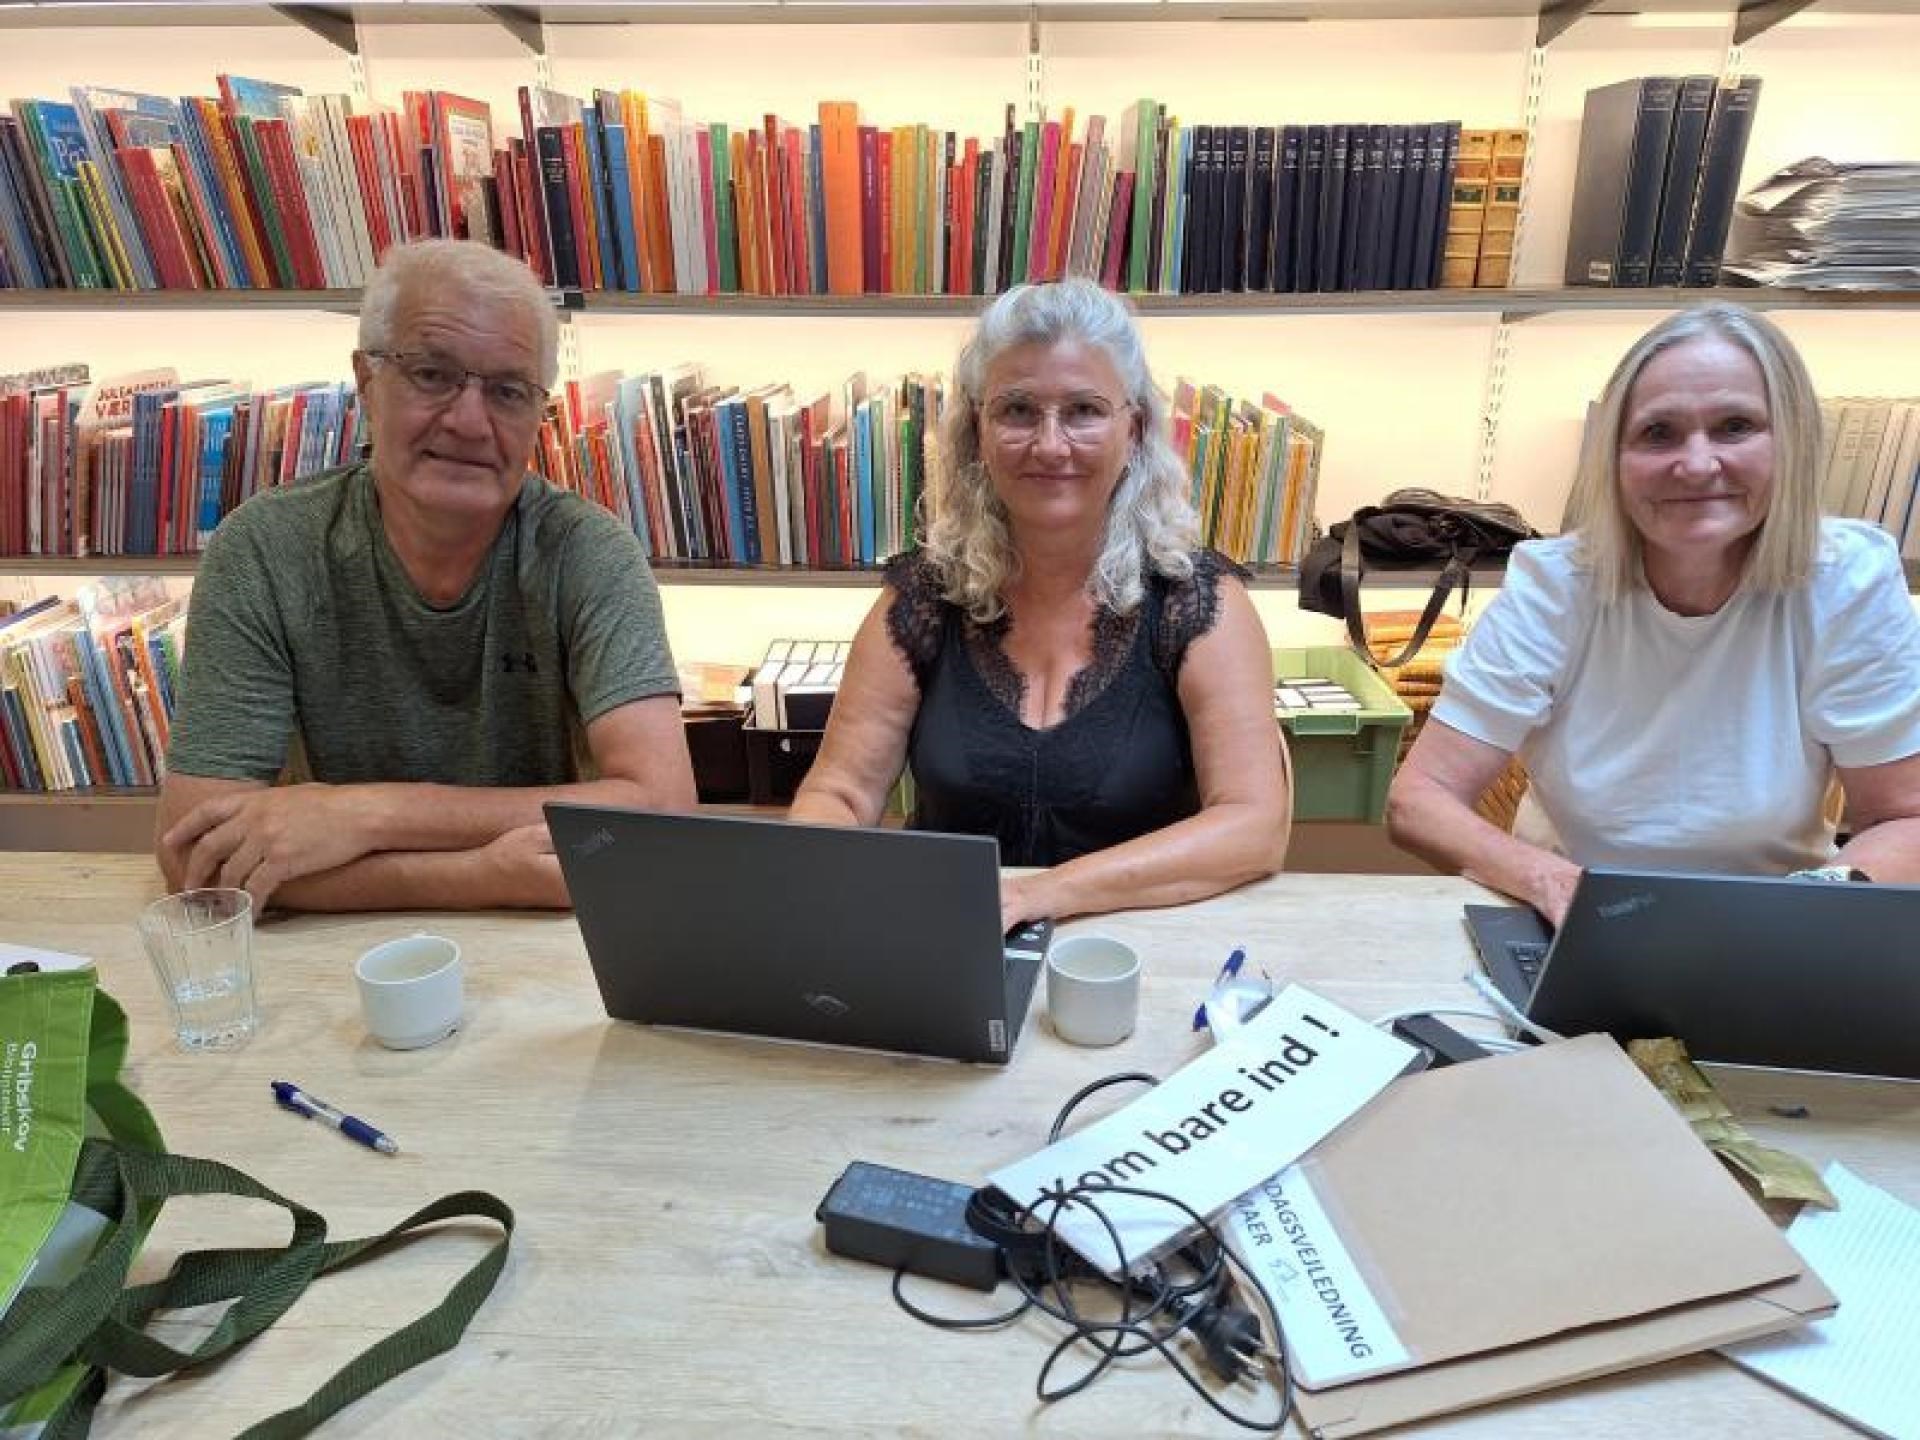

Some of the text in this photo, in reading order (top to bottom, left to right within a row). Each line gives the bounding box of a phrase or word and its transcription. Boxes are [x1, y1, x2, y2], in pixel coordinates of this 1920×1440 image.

[14, 1041, 37, 1152] Gribskov
[1144, 1089, 1254, 1155] bare
[1237, 1034, 1321, 1094] ind
[1301, 1014, 1340, 1038] !
[1262, 1182, 1373, 1359] DAGSVEJLEDNING
